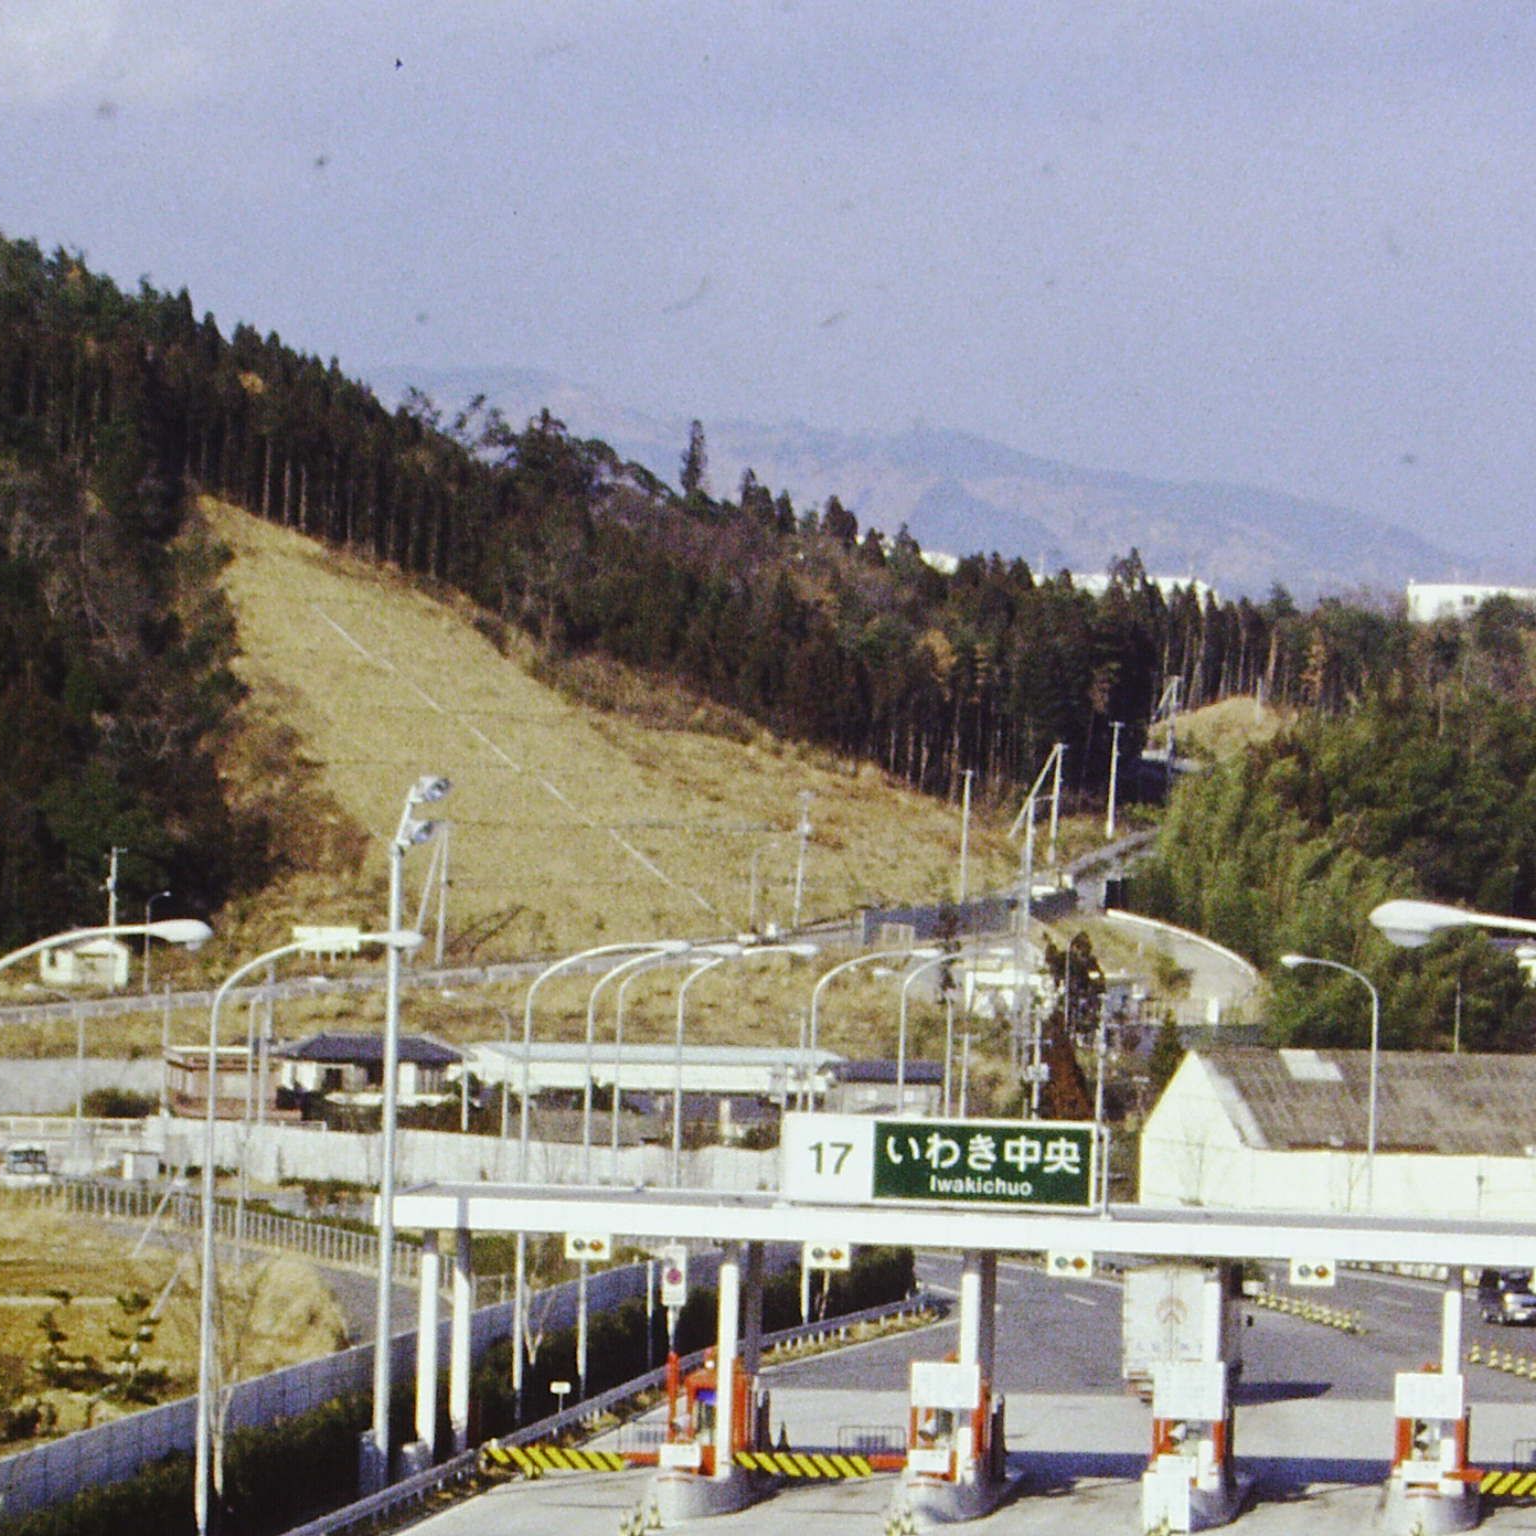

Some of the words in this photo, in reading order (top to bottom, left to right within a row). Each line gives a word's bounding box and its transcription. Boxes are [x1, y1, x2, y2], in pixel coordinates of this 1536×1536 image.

[809, 1142, 854, 1176] 17
[886, 1133, 1081, 1176] いわき中央
[930, 1174, 1033, 1197] Iwakichuo
